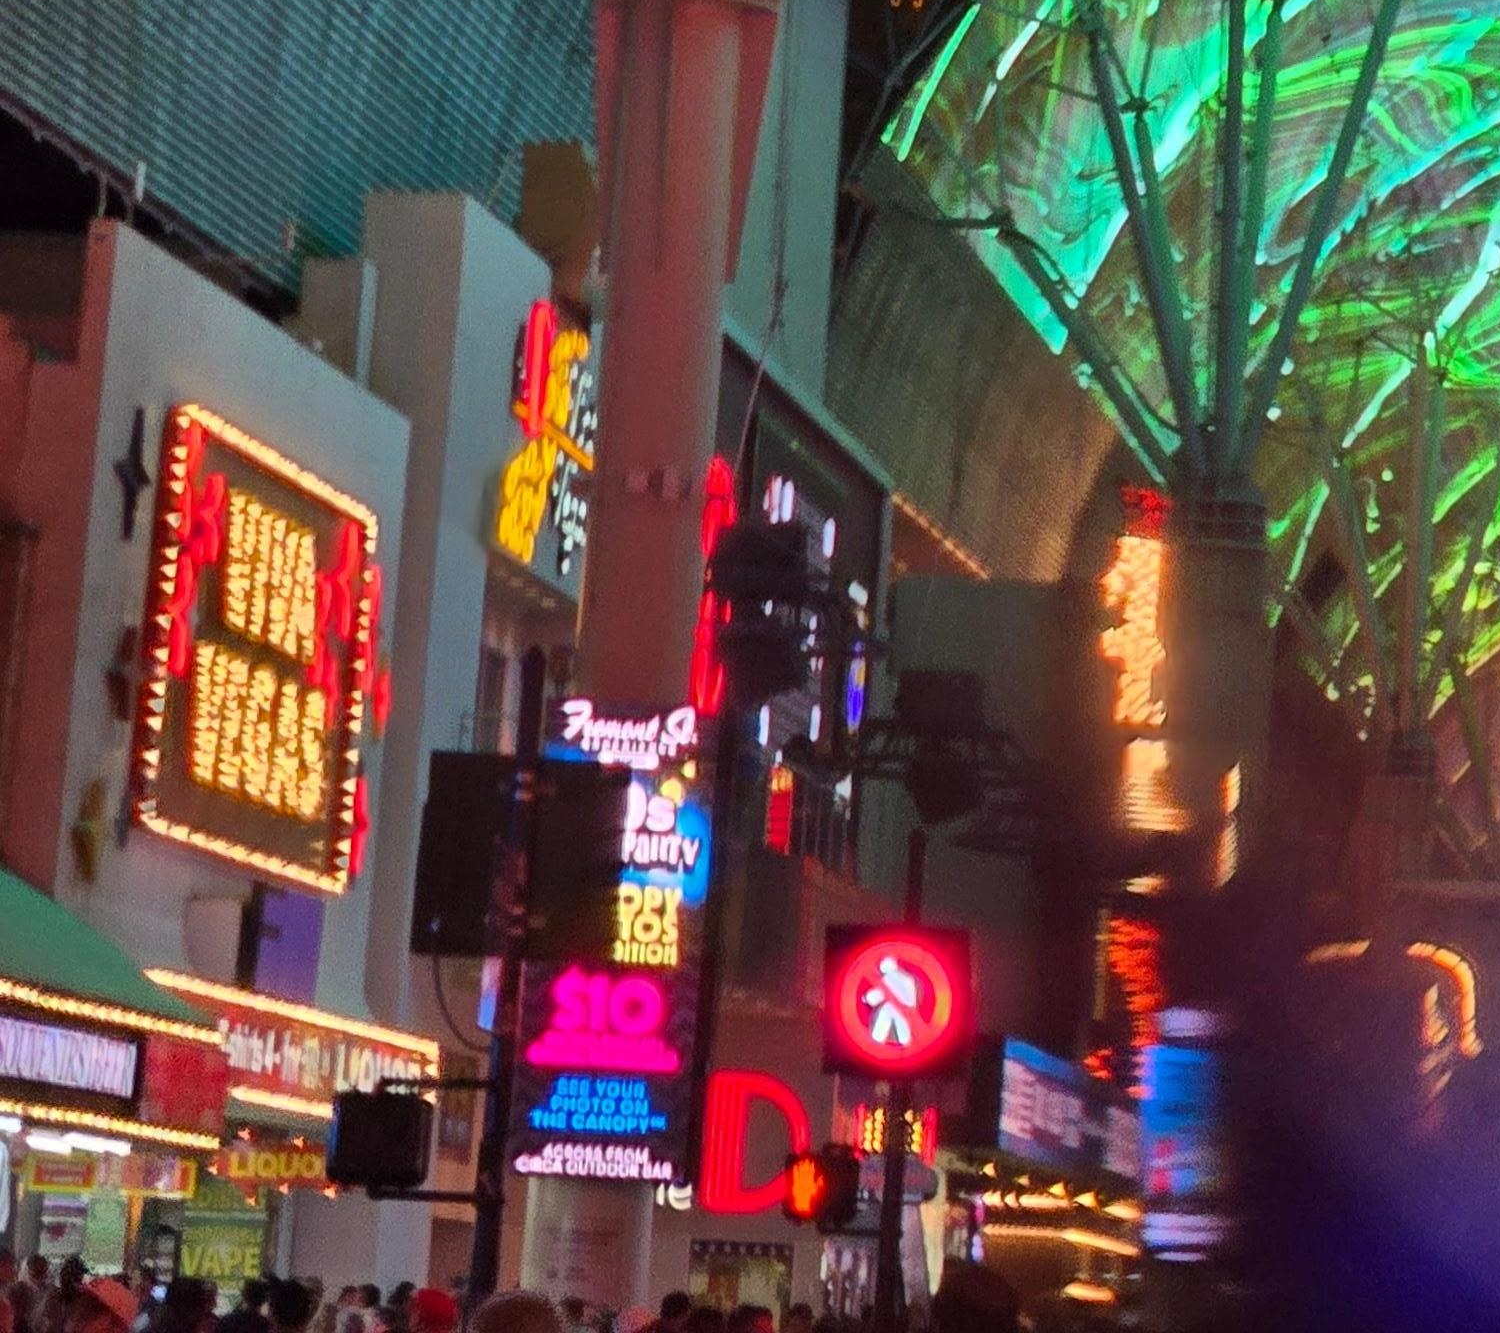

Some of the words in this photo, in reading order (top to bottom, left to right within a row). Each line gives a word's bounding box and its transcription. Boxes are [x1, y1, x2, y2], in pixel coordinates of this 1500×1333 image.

[562, 699, 660, 741] Fremont
[617, 883, 682, 916] OPY
[618, 912, 679, 944] TOS
[613, 939, 678, 965] DITION
[551, 964, 664, 1033] $10
[596, 1078, 646, 1100] YOUR
[550, 1096, 616, 1115] PHOTO
[619, 1098, 649, 1117] ON
[700, 1066, 812, 1214] D
[229, 1151, 324, 1179] LIQUO
[180, 1244, 261, 1277] VAPE
